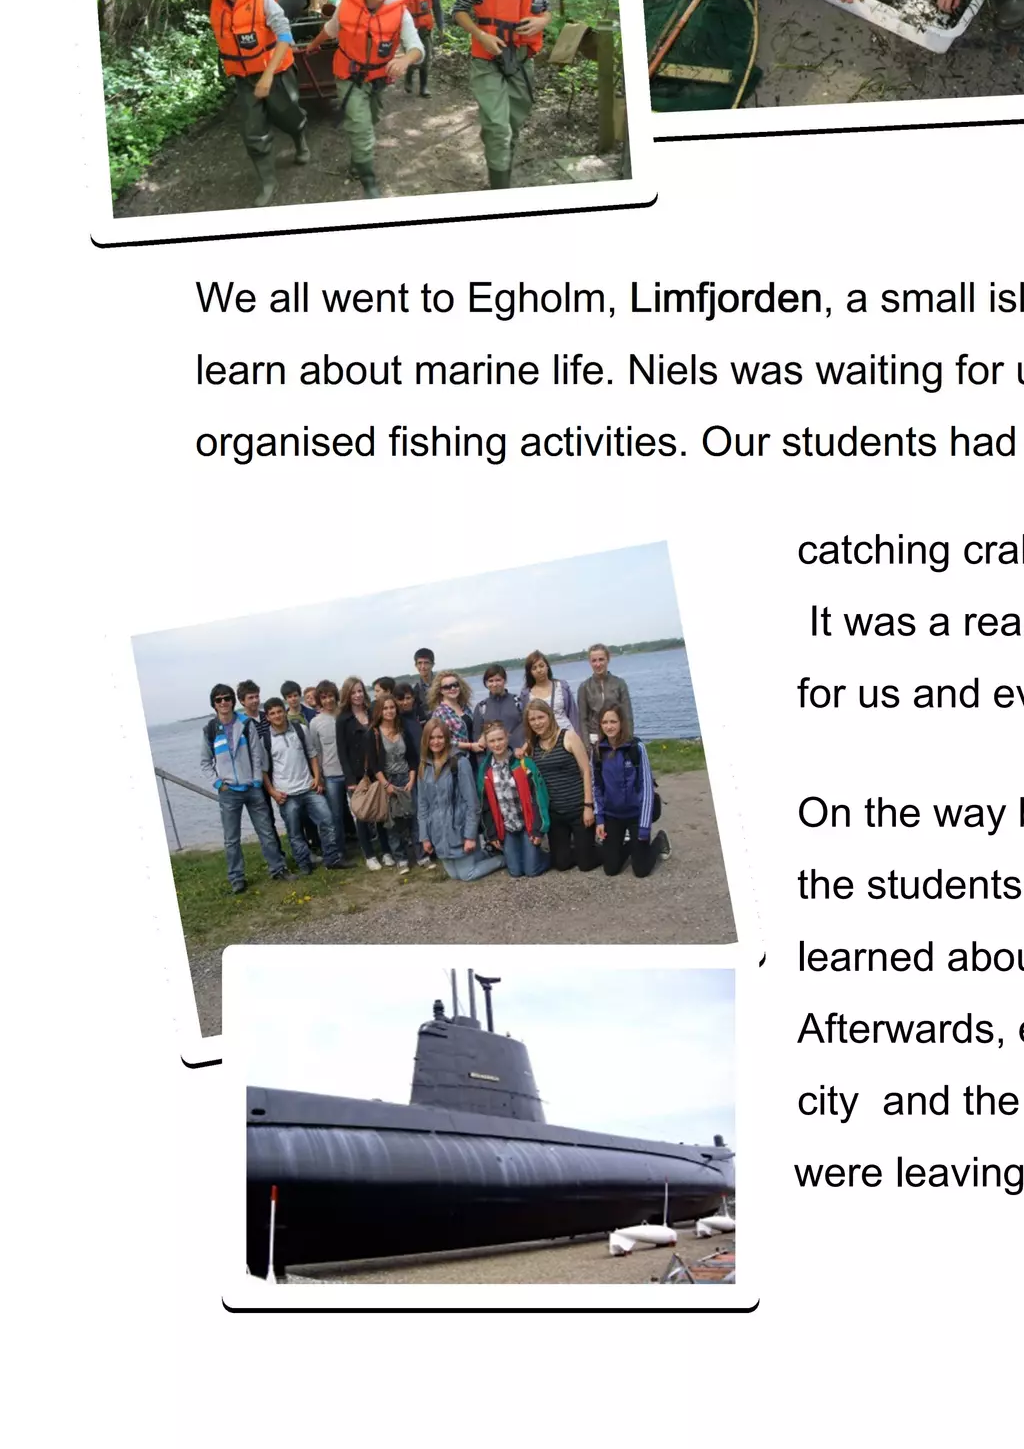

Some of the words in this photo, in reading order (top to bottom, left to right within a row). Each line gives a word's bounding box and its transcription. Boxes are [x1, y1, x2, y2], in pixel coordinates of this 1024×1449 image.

[196, 282, 256, 313] We
[270, 282, 308, 313] all
[322, 283, 409, 313] went
[421, 283, 454, 313] to
[470, 282, 614, 321] Egholm,
[632, 281, 831, 321] Limfjorden,
[847, 290, 867, 313] a
[881, 282, 974, 313] small
[198, 354, 285, 385] learn
[300, 354, 402, 385] about
[416, 354, 539, 385] marine
[554, 354, 612, 385] life.
[630, 354, 717, 385] Niels
[731, 362, 802, 385] was
[816, 354, 942, 393] waiting
[956, 354, 1004, 385] for
[197, 426, 374, 465] organised
[389, 425, 505, 465] fishing
[521, 426, 686, 456] activities.
[703, 425, 771, 456] Our
[783, 426, 936, 456] students
[951, 426, 1015, 456] had
[799, 534, 949, 572] catching
[812, 605, 831, 636] It
[844, 613, 915, 636] was
[930, 613, 949, 636] a
[797, 677, 846, 708] for
[860, 685, 899, 708] us
[914, 678, 978, 708] and
[799, 796, 850, 827] On
[865, 797, 920, 827] the
[933, 805, 1006, 836] way
[798, 869, 853, 899] the
[868, 869, 1021, 899] students
[800, 941, 933, 972] learned
[797, 1012, 1003, 1048] Afterwards,
[799, 1085, 859, 1123] city
[884, 1085, 948, 1115] and
[963, 1085, 1019, 1115] the
[794, 1164, 882, 1187] were
[898, 1156, 1023, 1195] leaving
